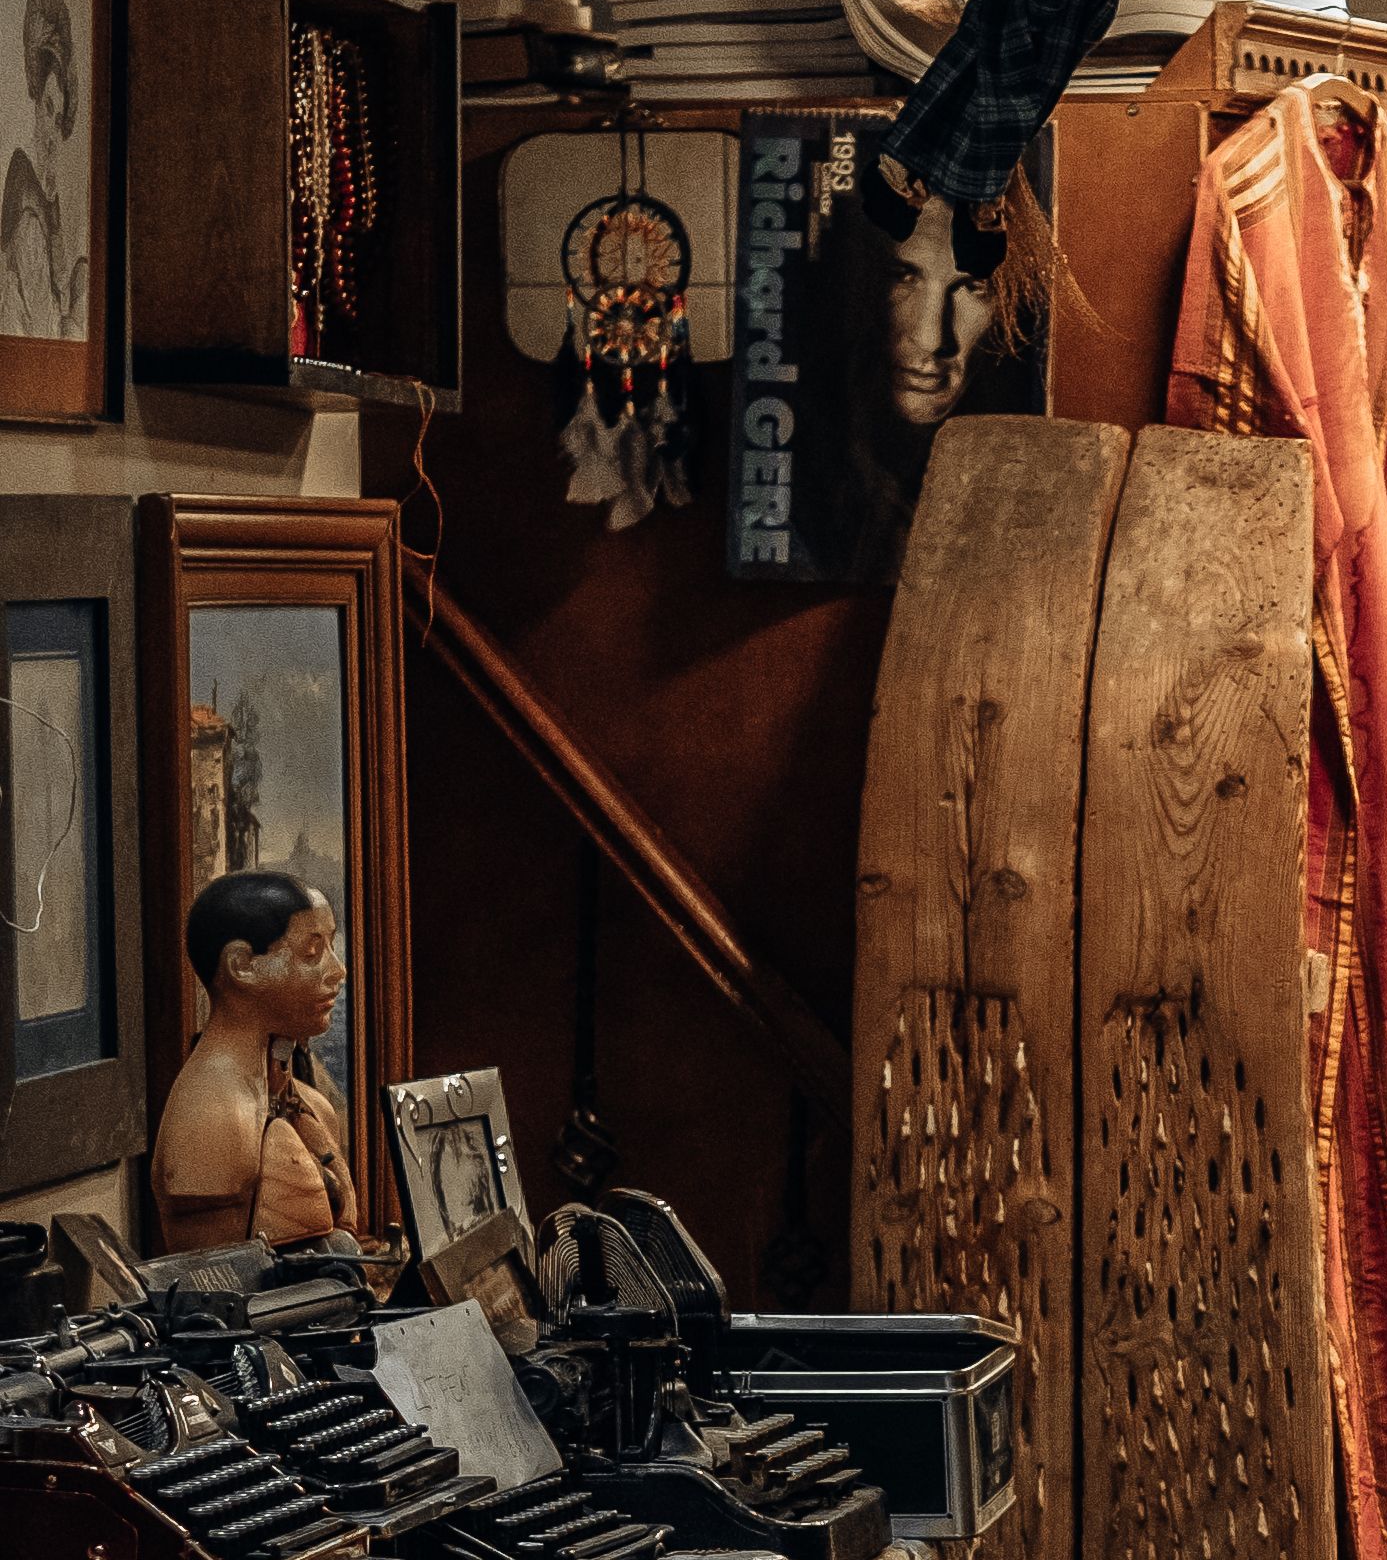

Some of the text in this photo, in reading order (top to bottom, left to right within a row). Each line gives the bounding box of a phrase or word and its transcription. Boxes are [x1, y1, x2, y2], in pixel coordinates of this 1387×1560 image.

[831, 131, 856, 191] 1993
[739, 138, 805, 563] Richard GERE
